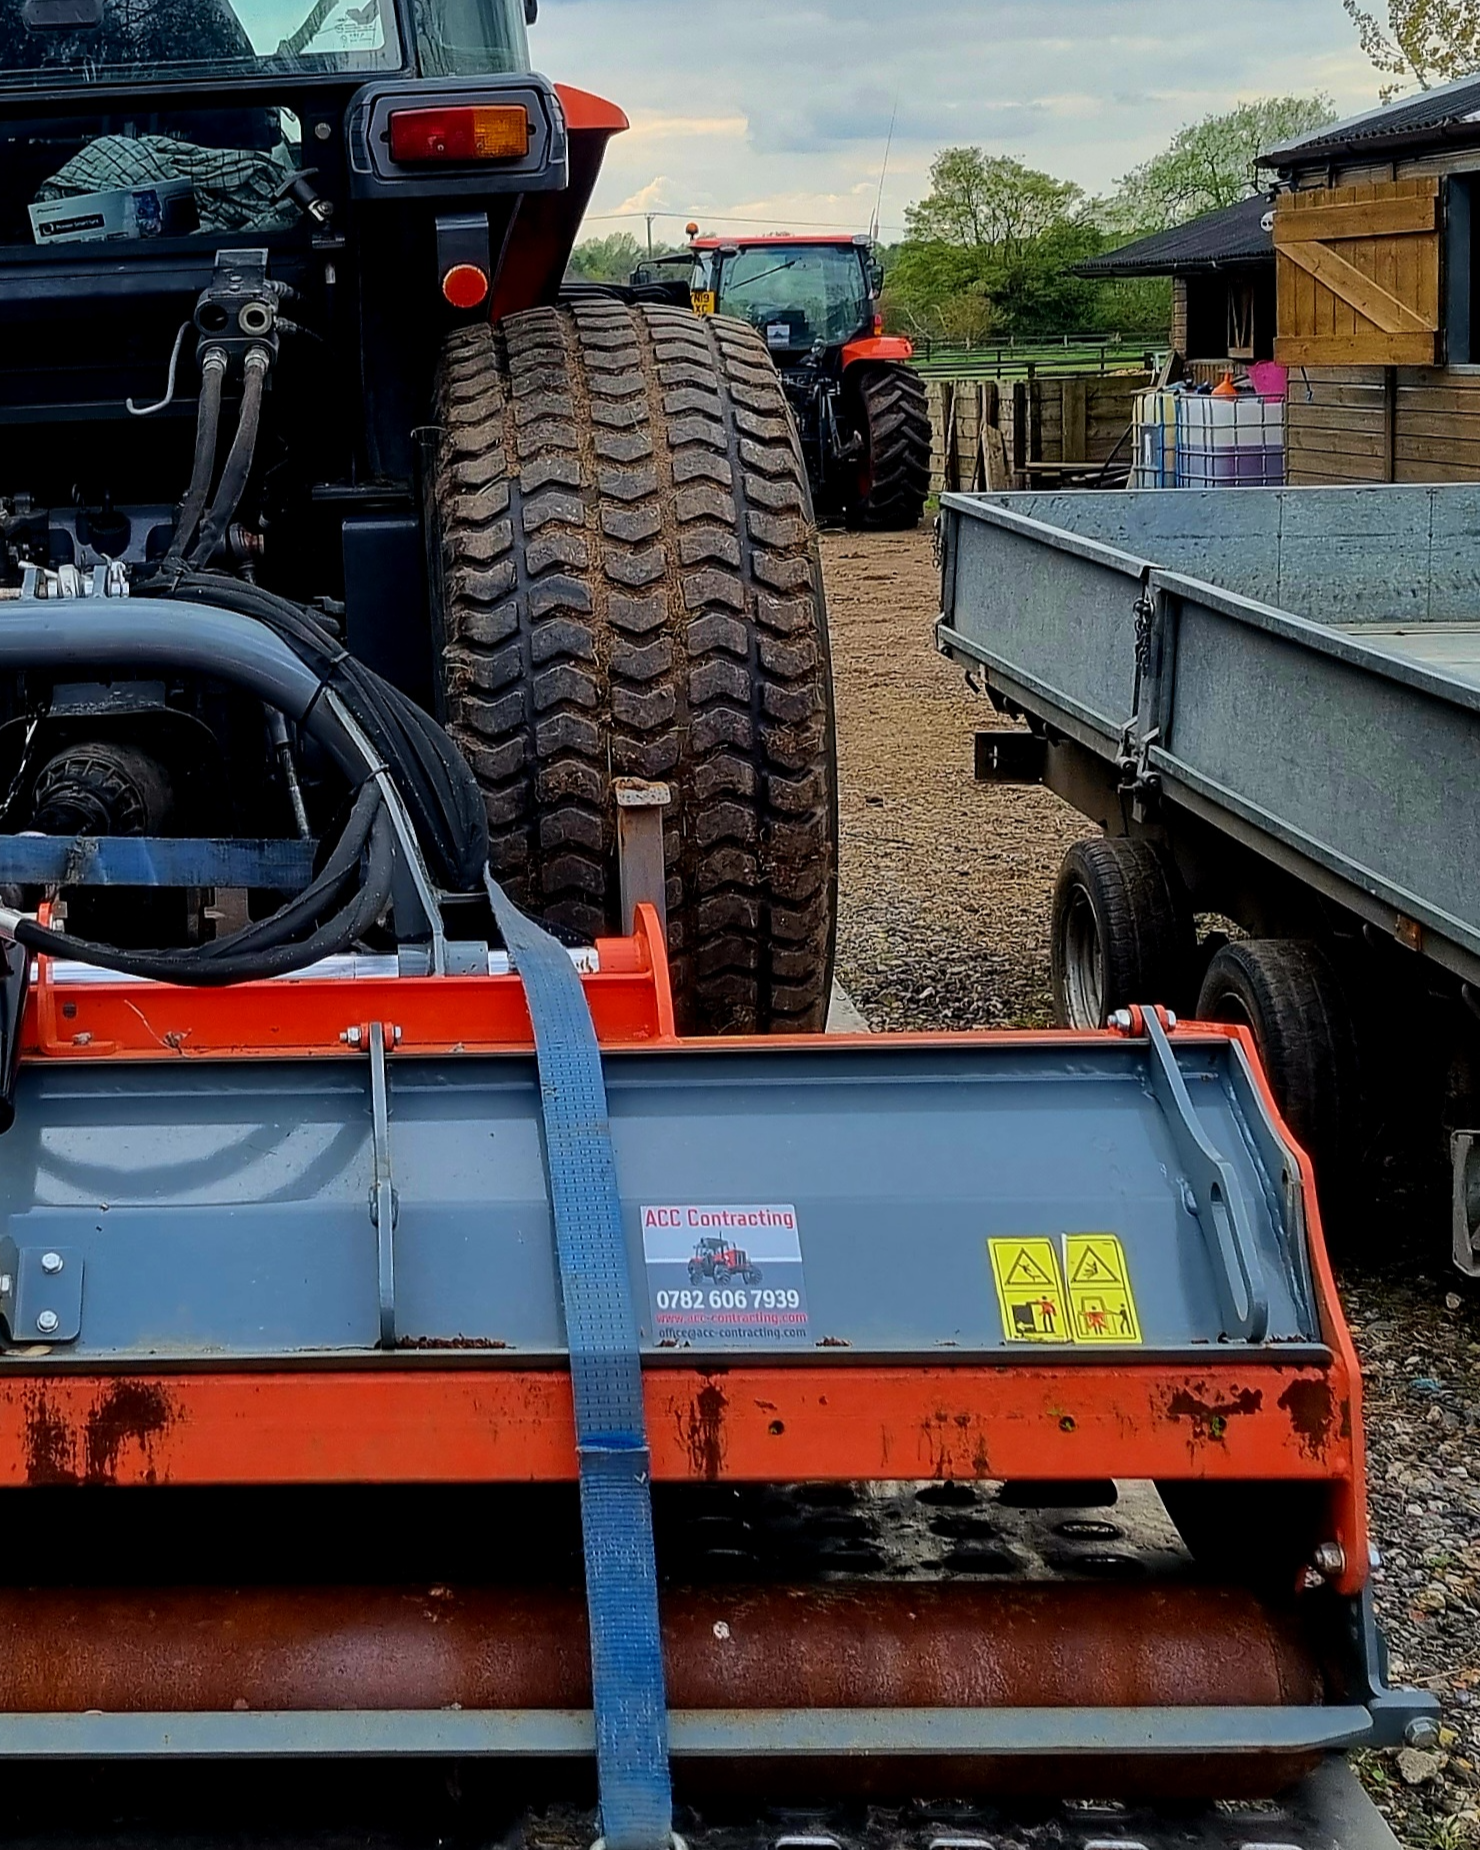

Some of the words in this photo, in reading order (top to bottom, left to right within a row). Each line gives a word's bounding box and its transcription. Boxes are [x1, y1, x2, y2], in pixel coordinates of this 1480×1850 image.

[645, 1209, 681, 1227] ACC
[687, 1209, 795, 1229] Contracting
[656, 1290, 705, 1309] 0782
[708, 1290, 747, 1309] 606
[750, 1289, 800, 1309] 7939
[656, 1312, 808, 1325] www.acc-contracting.com
[659, 1327, 807, 1340] office@acc-contracting.com
